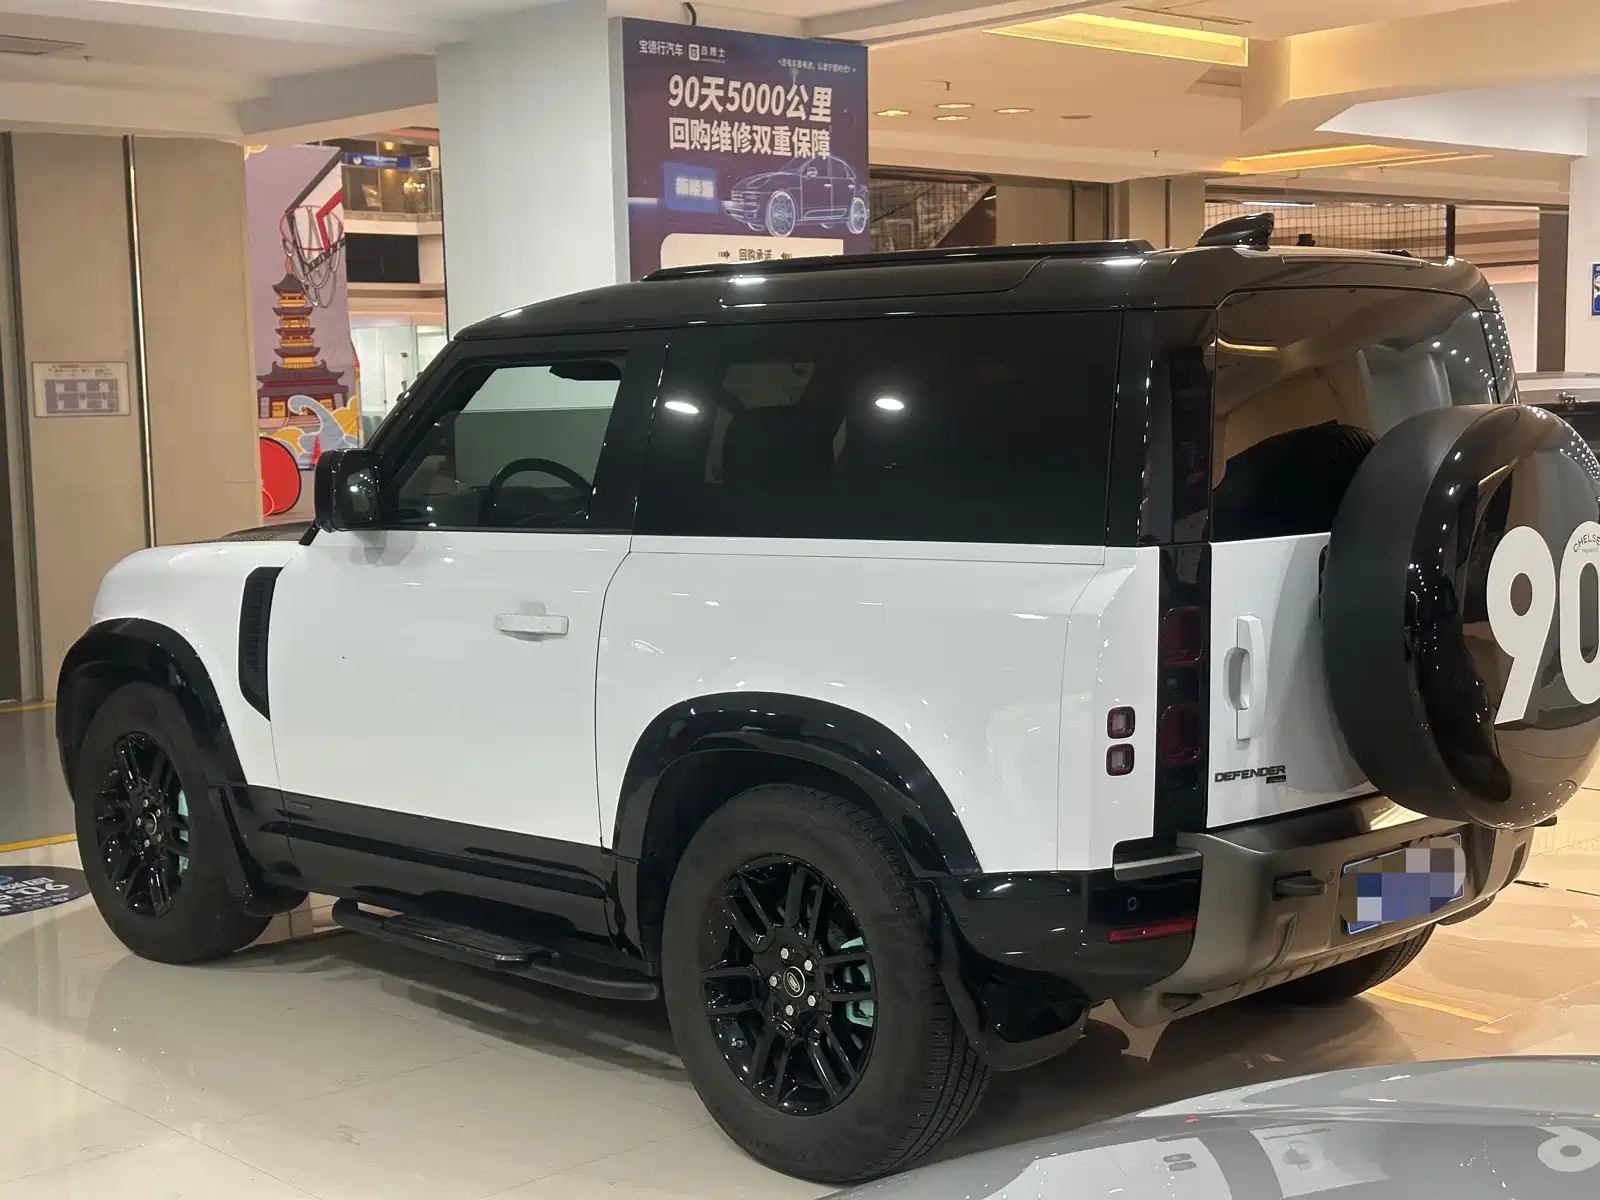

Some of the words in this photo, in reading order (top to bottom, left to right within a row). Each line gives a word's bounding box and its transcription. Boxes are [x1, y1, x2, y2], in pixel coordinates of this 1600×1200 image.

[639, 40, 683, 57] 宝德行汽车
[668, 74, 832, 122] 90天5000公里
[668, 117, 831, 159] 回购维修双重保障
[1486, 521, 1600, 724] 90
[1214, 765, 1286, 782] DEFENDER
